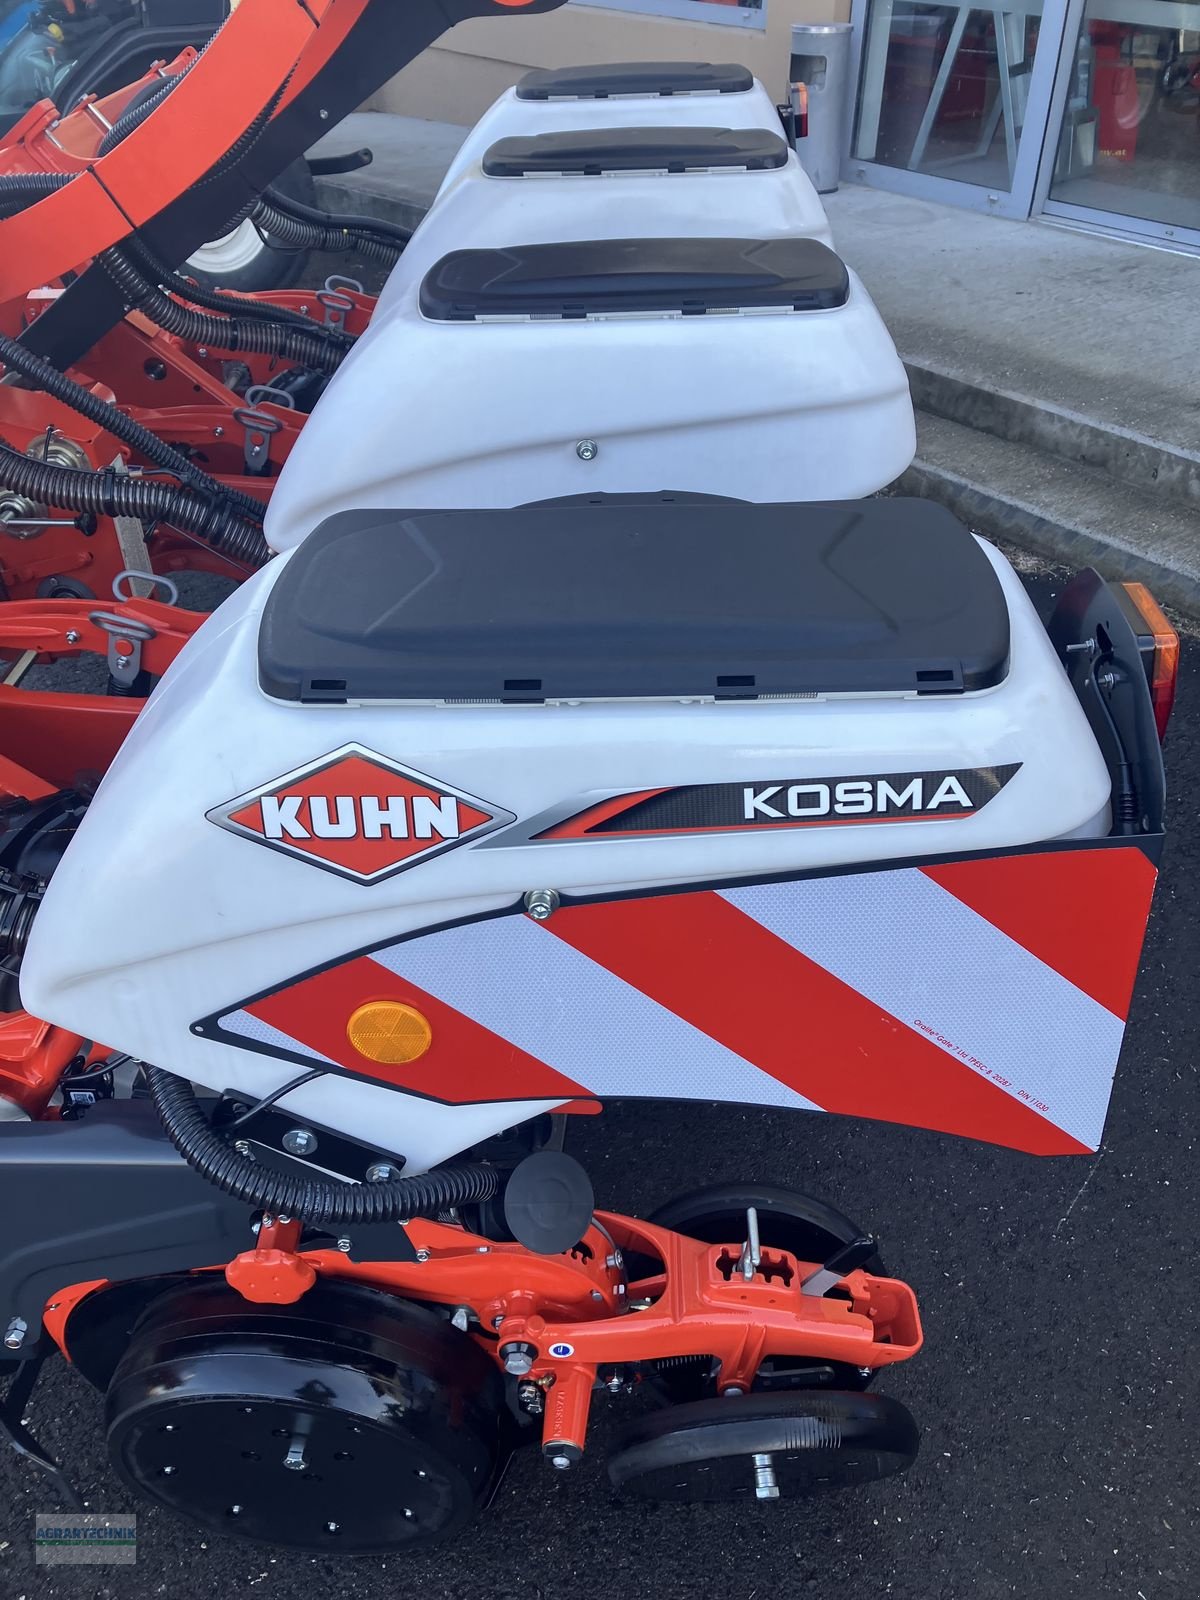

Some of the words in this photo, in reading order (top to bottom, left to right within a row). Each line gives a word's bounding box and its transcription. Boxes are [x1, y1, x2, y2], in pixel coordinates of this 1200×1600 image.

[260, 796, 460, 839] KUHN
[744, 775, 973, 819] KOSMA
[936, 1035, 953, 1048] Gate
[957, 1049, 969, 1058] Ltd
[1017, 1090, 1031, 1100] DIN
[1030, 1098, 1049, 1112] 11030
